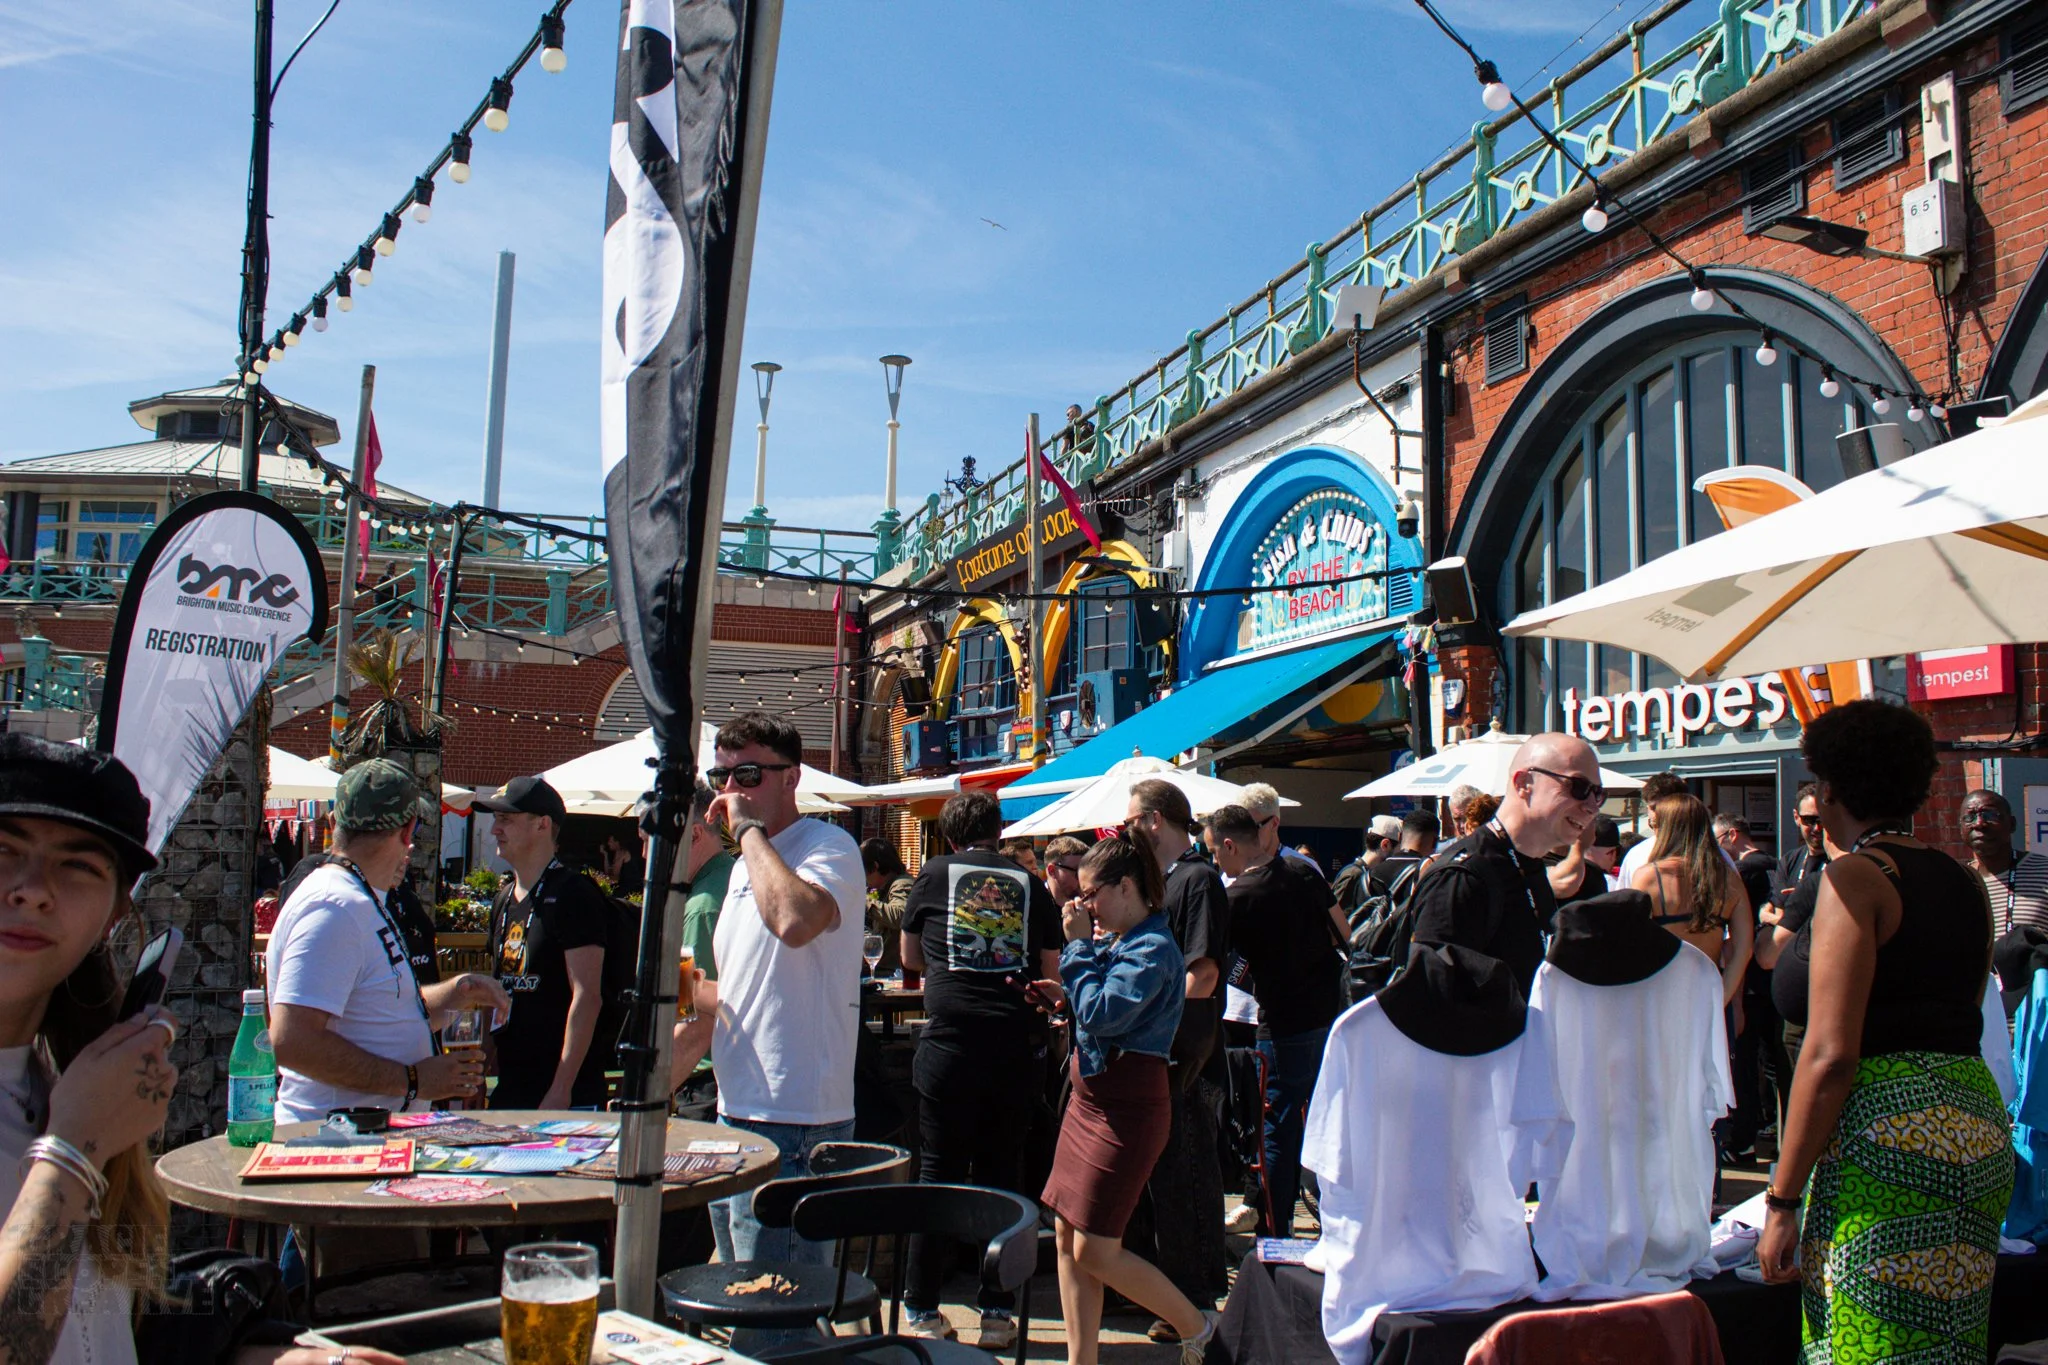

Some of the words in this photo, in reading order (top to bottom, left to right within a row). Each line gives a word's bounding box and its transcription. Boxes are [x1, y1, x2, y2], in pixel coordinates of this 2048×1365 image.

[1300, 514, 1317, 549] &
[176, 552, 300, 609] bmc
[1288, 567, 1308, 587] BY
[1312, 555, 1344, 584] THE
[176, 594, 217, 611] BRIGHTON
[217, 600, 243, 614] MUSIC
[242, 605, 293, 623] CONFERENCE
[1289, 584, 1344, 621] BEACH
[145, 627, 267, 664] REGISTRATION
[1916, 664, 1989, 688] tempest
[1563, 671, 1801, 748] tempes
